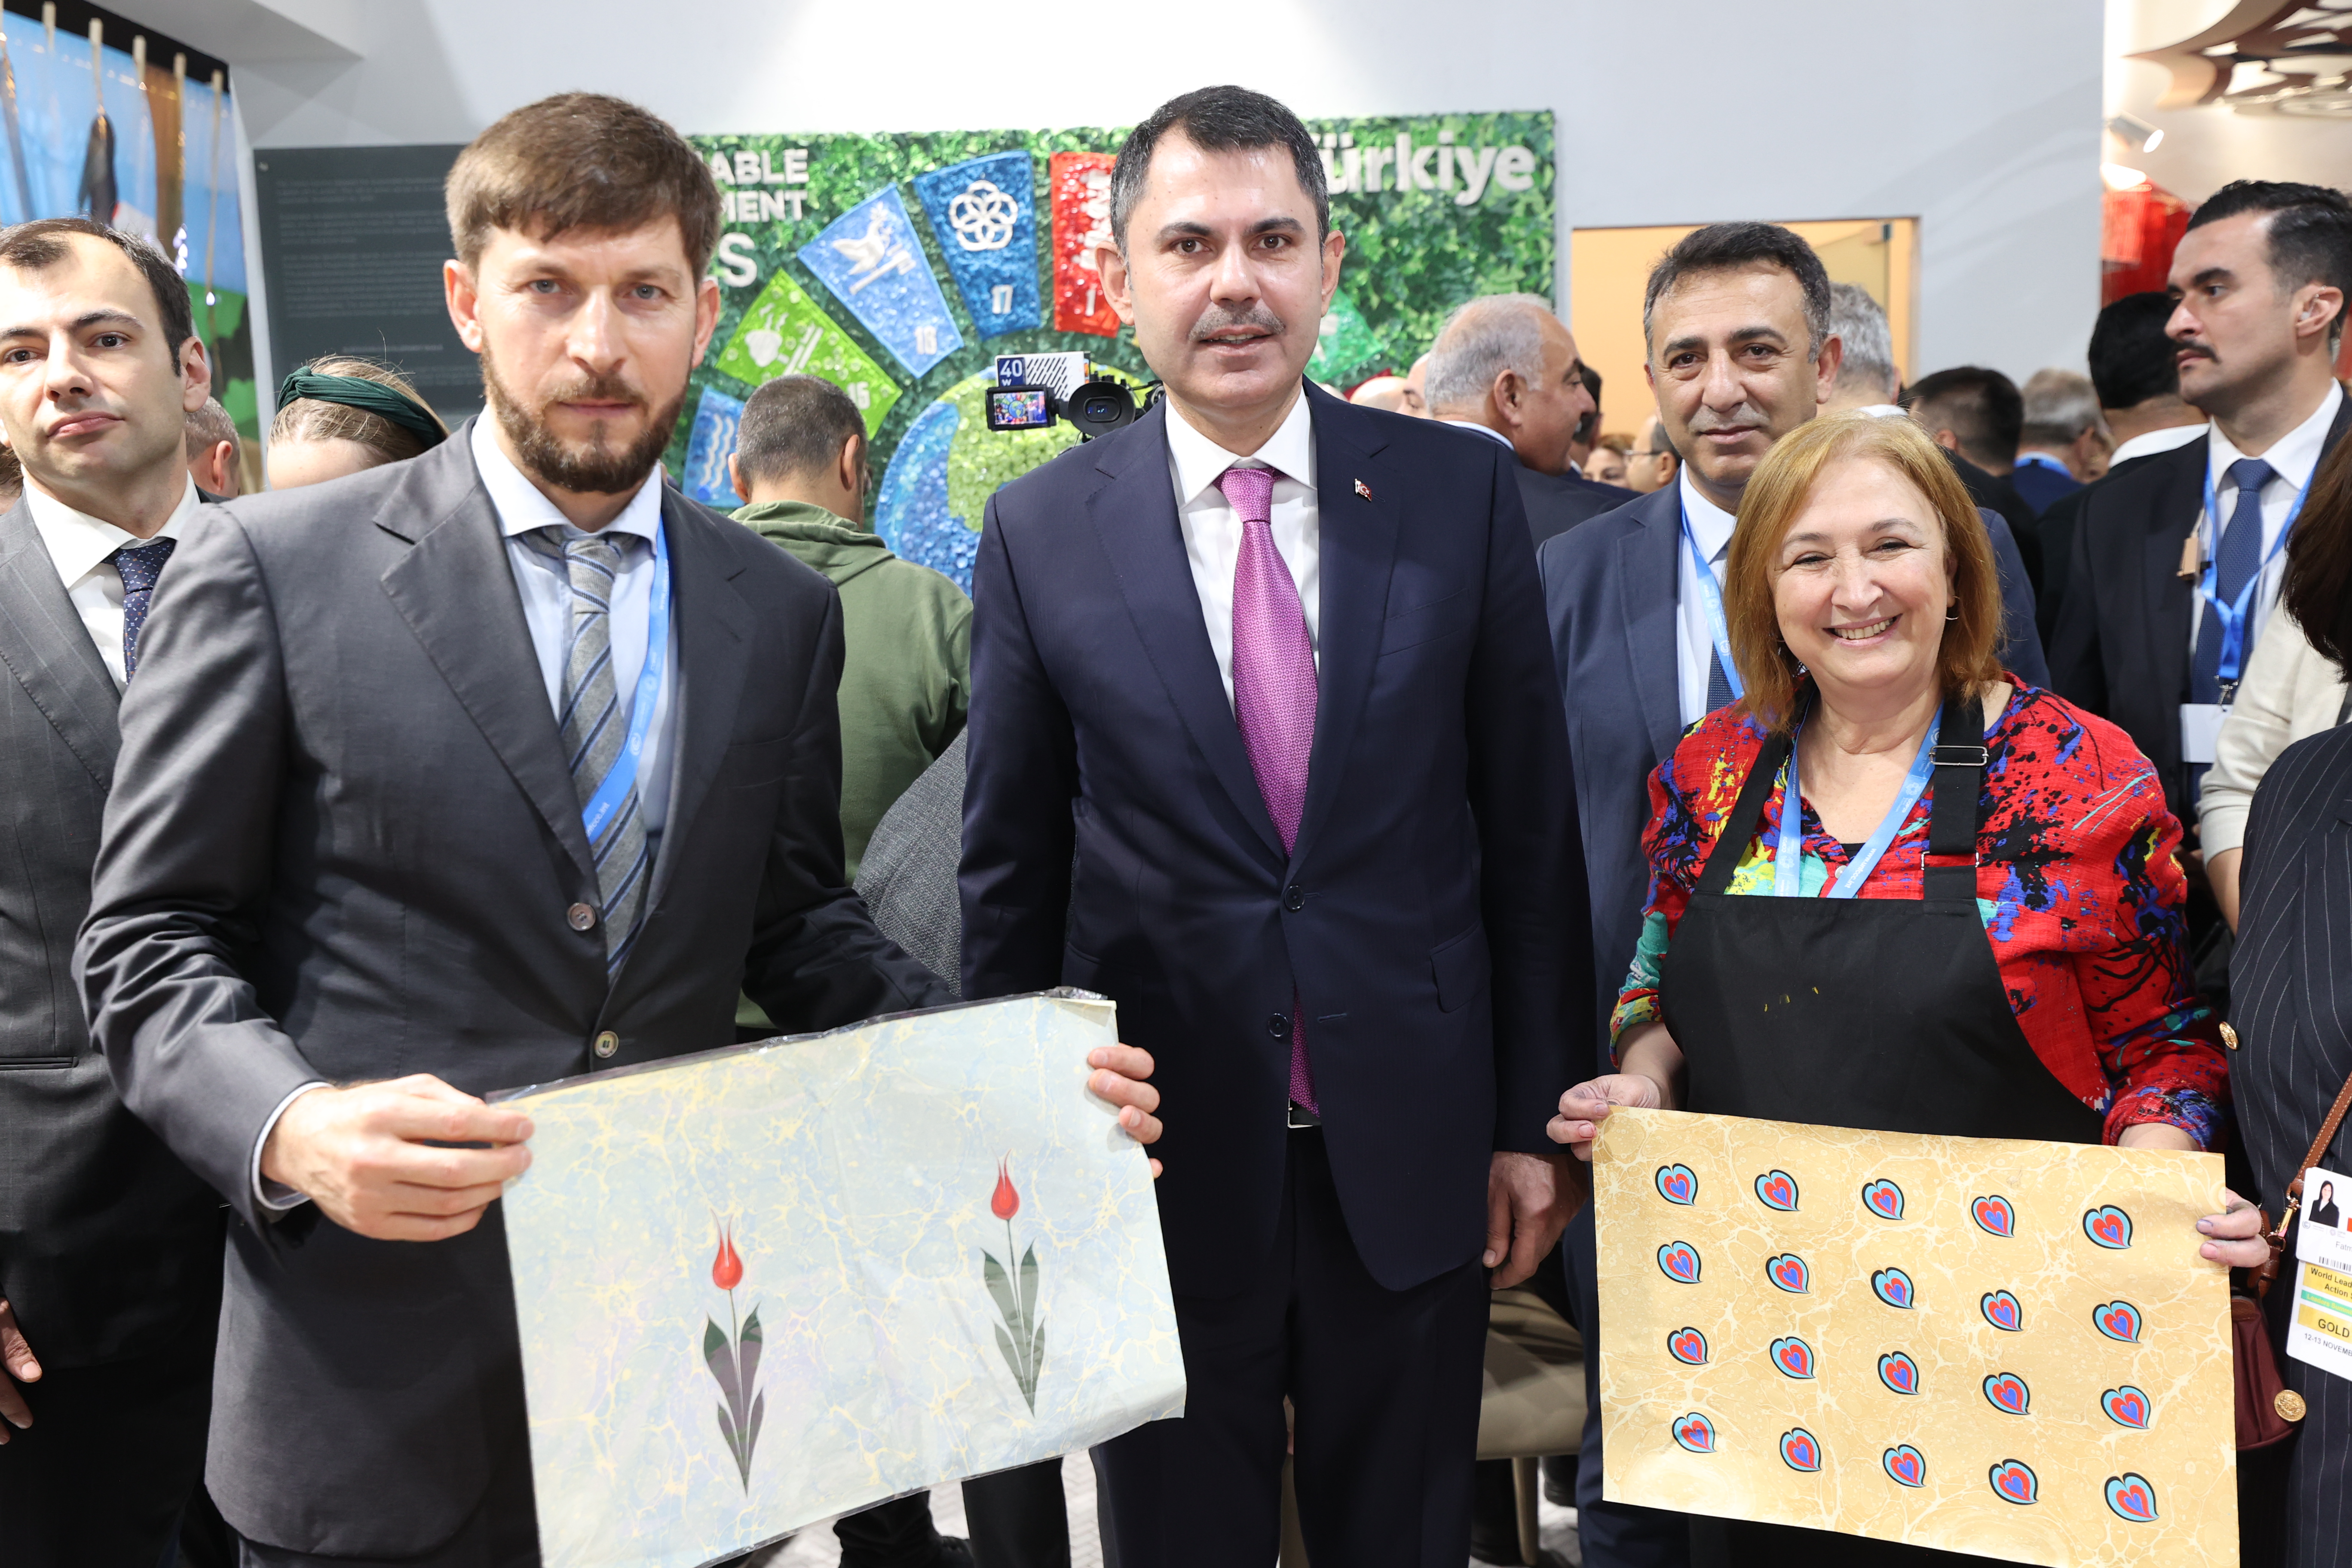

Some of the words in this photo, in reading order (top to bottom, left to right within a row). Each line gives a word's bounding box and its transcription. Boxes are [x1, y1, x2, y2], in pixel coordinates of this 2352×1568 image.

[695, 149, 809, 185] ABLE
[1312, 132, 1536, 206] ürkiye
[705, 232, 758, 288] S
[1000, 359, 1023, 378] 40
[1844, 848, 1877, 888] www.unfccc.int
[2311, 1267, 2332, 1281] World
[2324, 1283, 2348, 1298] Action
[2318, 1318, 2350, 1338] GOLD
[2305, 1333, 2321, 1344] 12-13
